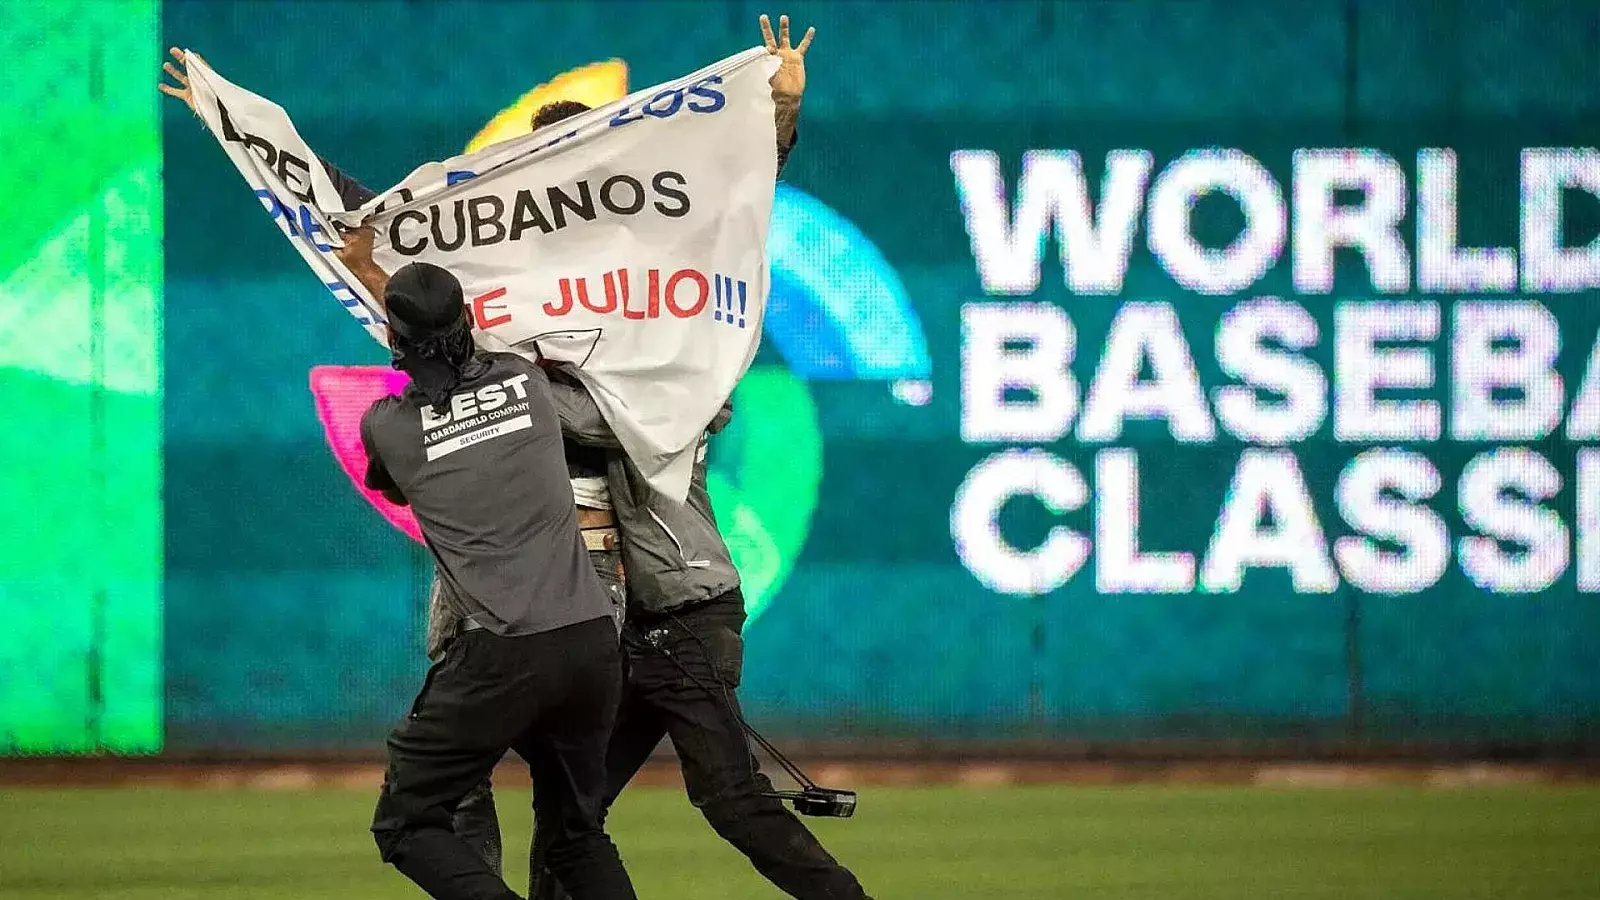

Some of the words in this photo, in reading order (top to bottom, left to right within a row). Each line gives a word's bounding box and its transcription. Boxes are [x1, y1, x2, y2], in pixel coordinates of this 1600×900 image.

[389, 171, 691, 256] CUBANOS
[950, 146, 1600, 295] WORLD
[542, 268, 748, 329] JULIO!!!
[424, 435, 431, 444] A
[430, 415, 488, 440] GARDAWORLD
[488, 402, 530, 420] COMPANY
[459, 426, 501, 446] SECURITY
